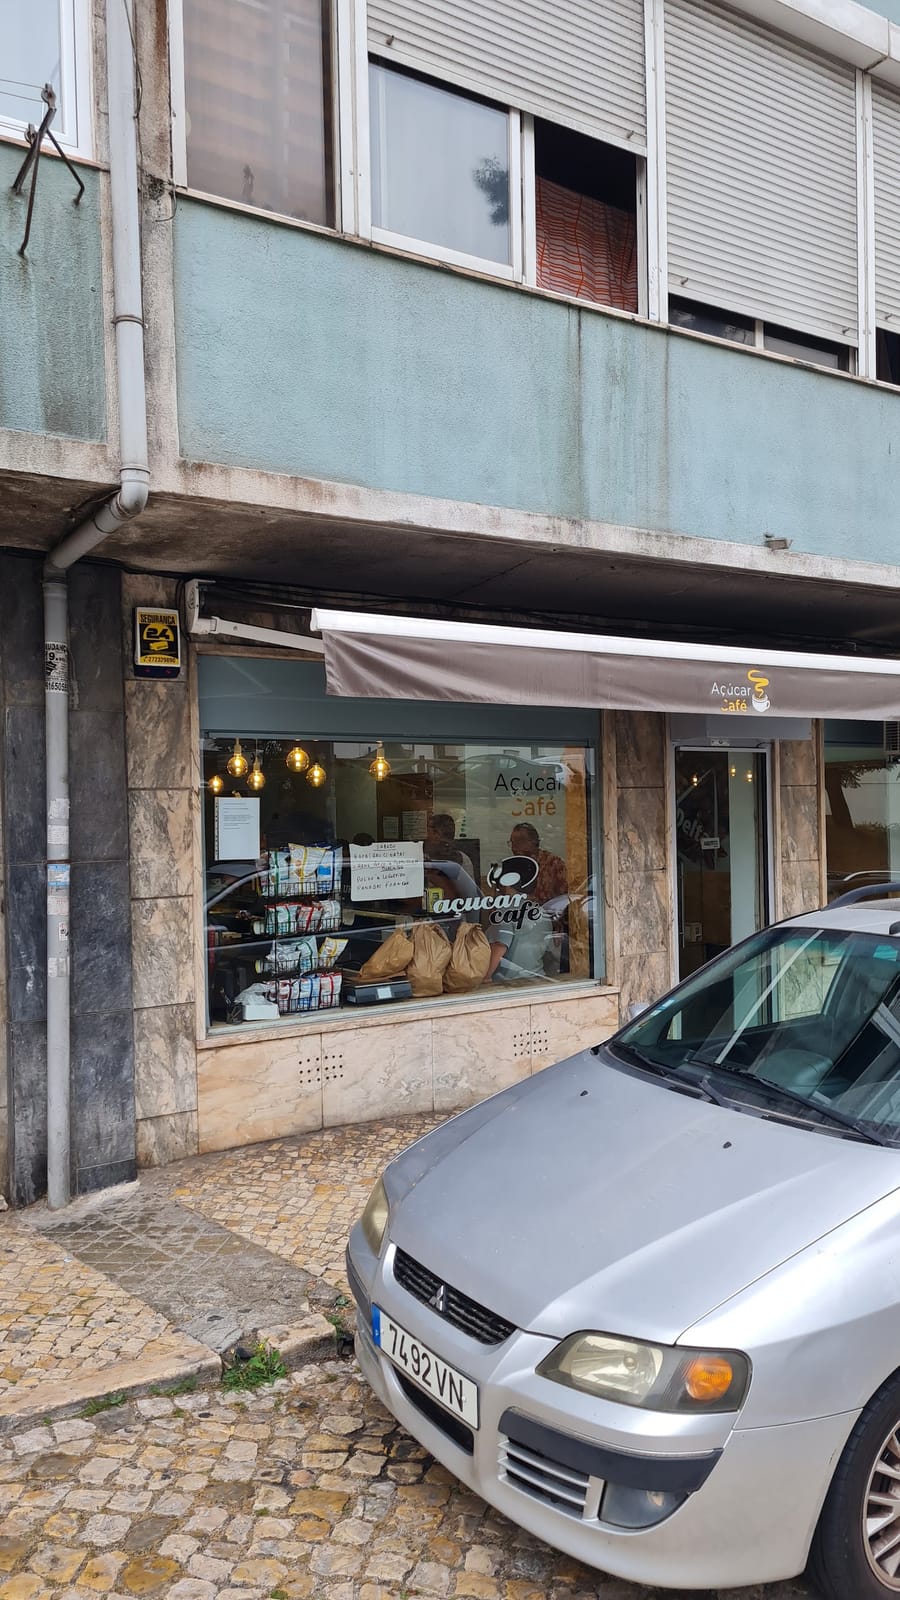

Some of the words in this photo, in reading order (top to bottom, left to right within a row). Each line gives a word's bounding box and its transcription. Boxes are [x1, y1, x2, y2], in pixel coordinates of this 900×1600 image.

[146, 627, 170, 640] 24
[711, 682, 752, 697] Açúcar
[494, 772, 562, 795] Açúcar
[433, 893, 528, 918] açucar
[490, 901, 543, 930] café
[388, 1322, 464, 1413] 7492VN
